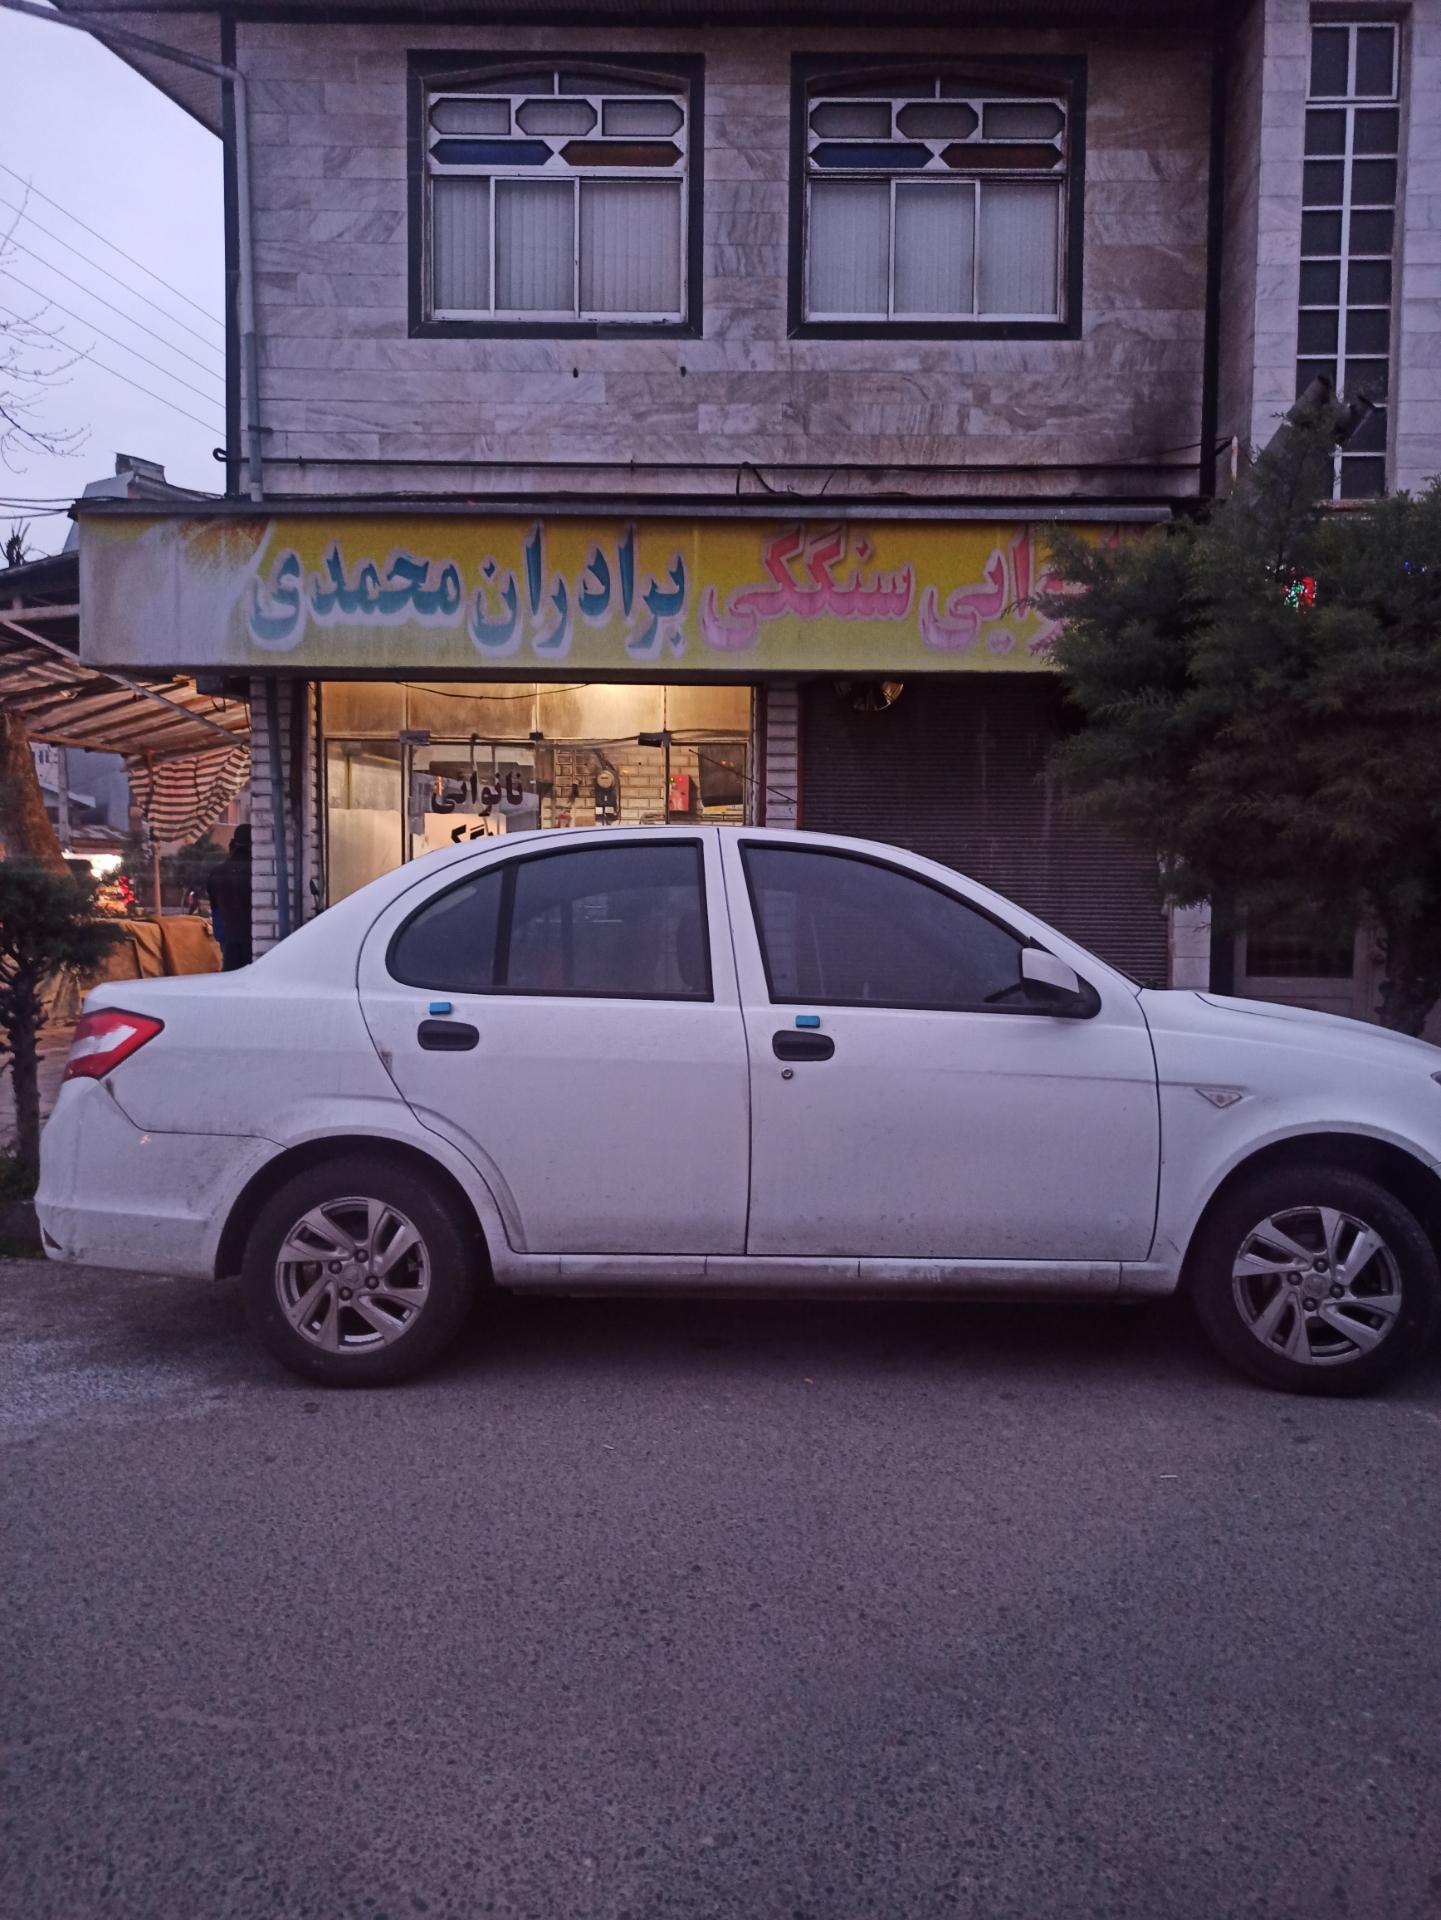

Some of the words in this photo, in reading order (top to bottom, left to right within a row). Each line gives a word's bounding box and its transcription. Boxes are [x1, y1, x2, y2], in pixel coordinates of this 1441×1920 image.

[251, 540, 464, 644] محمدی
[472, 518, 692, 655] برادران
[702, 523, 914, 652] سنگکی
